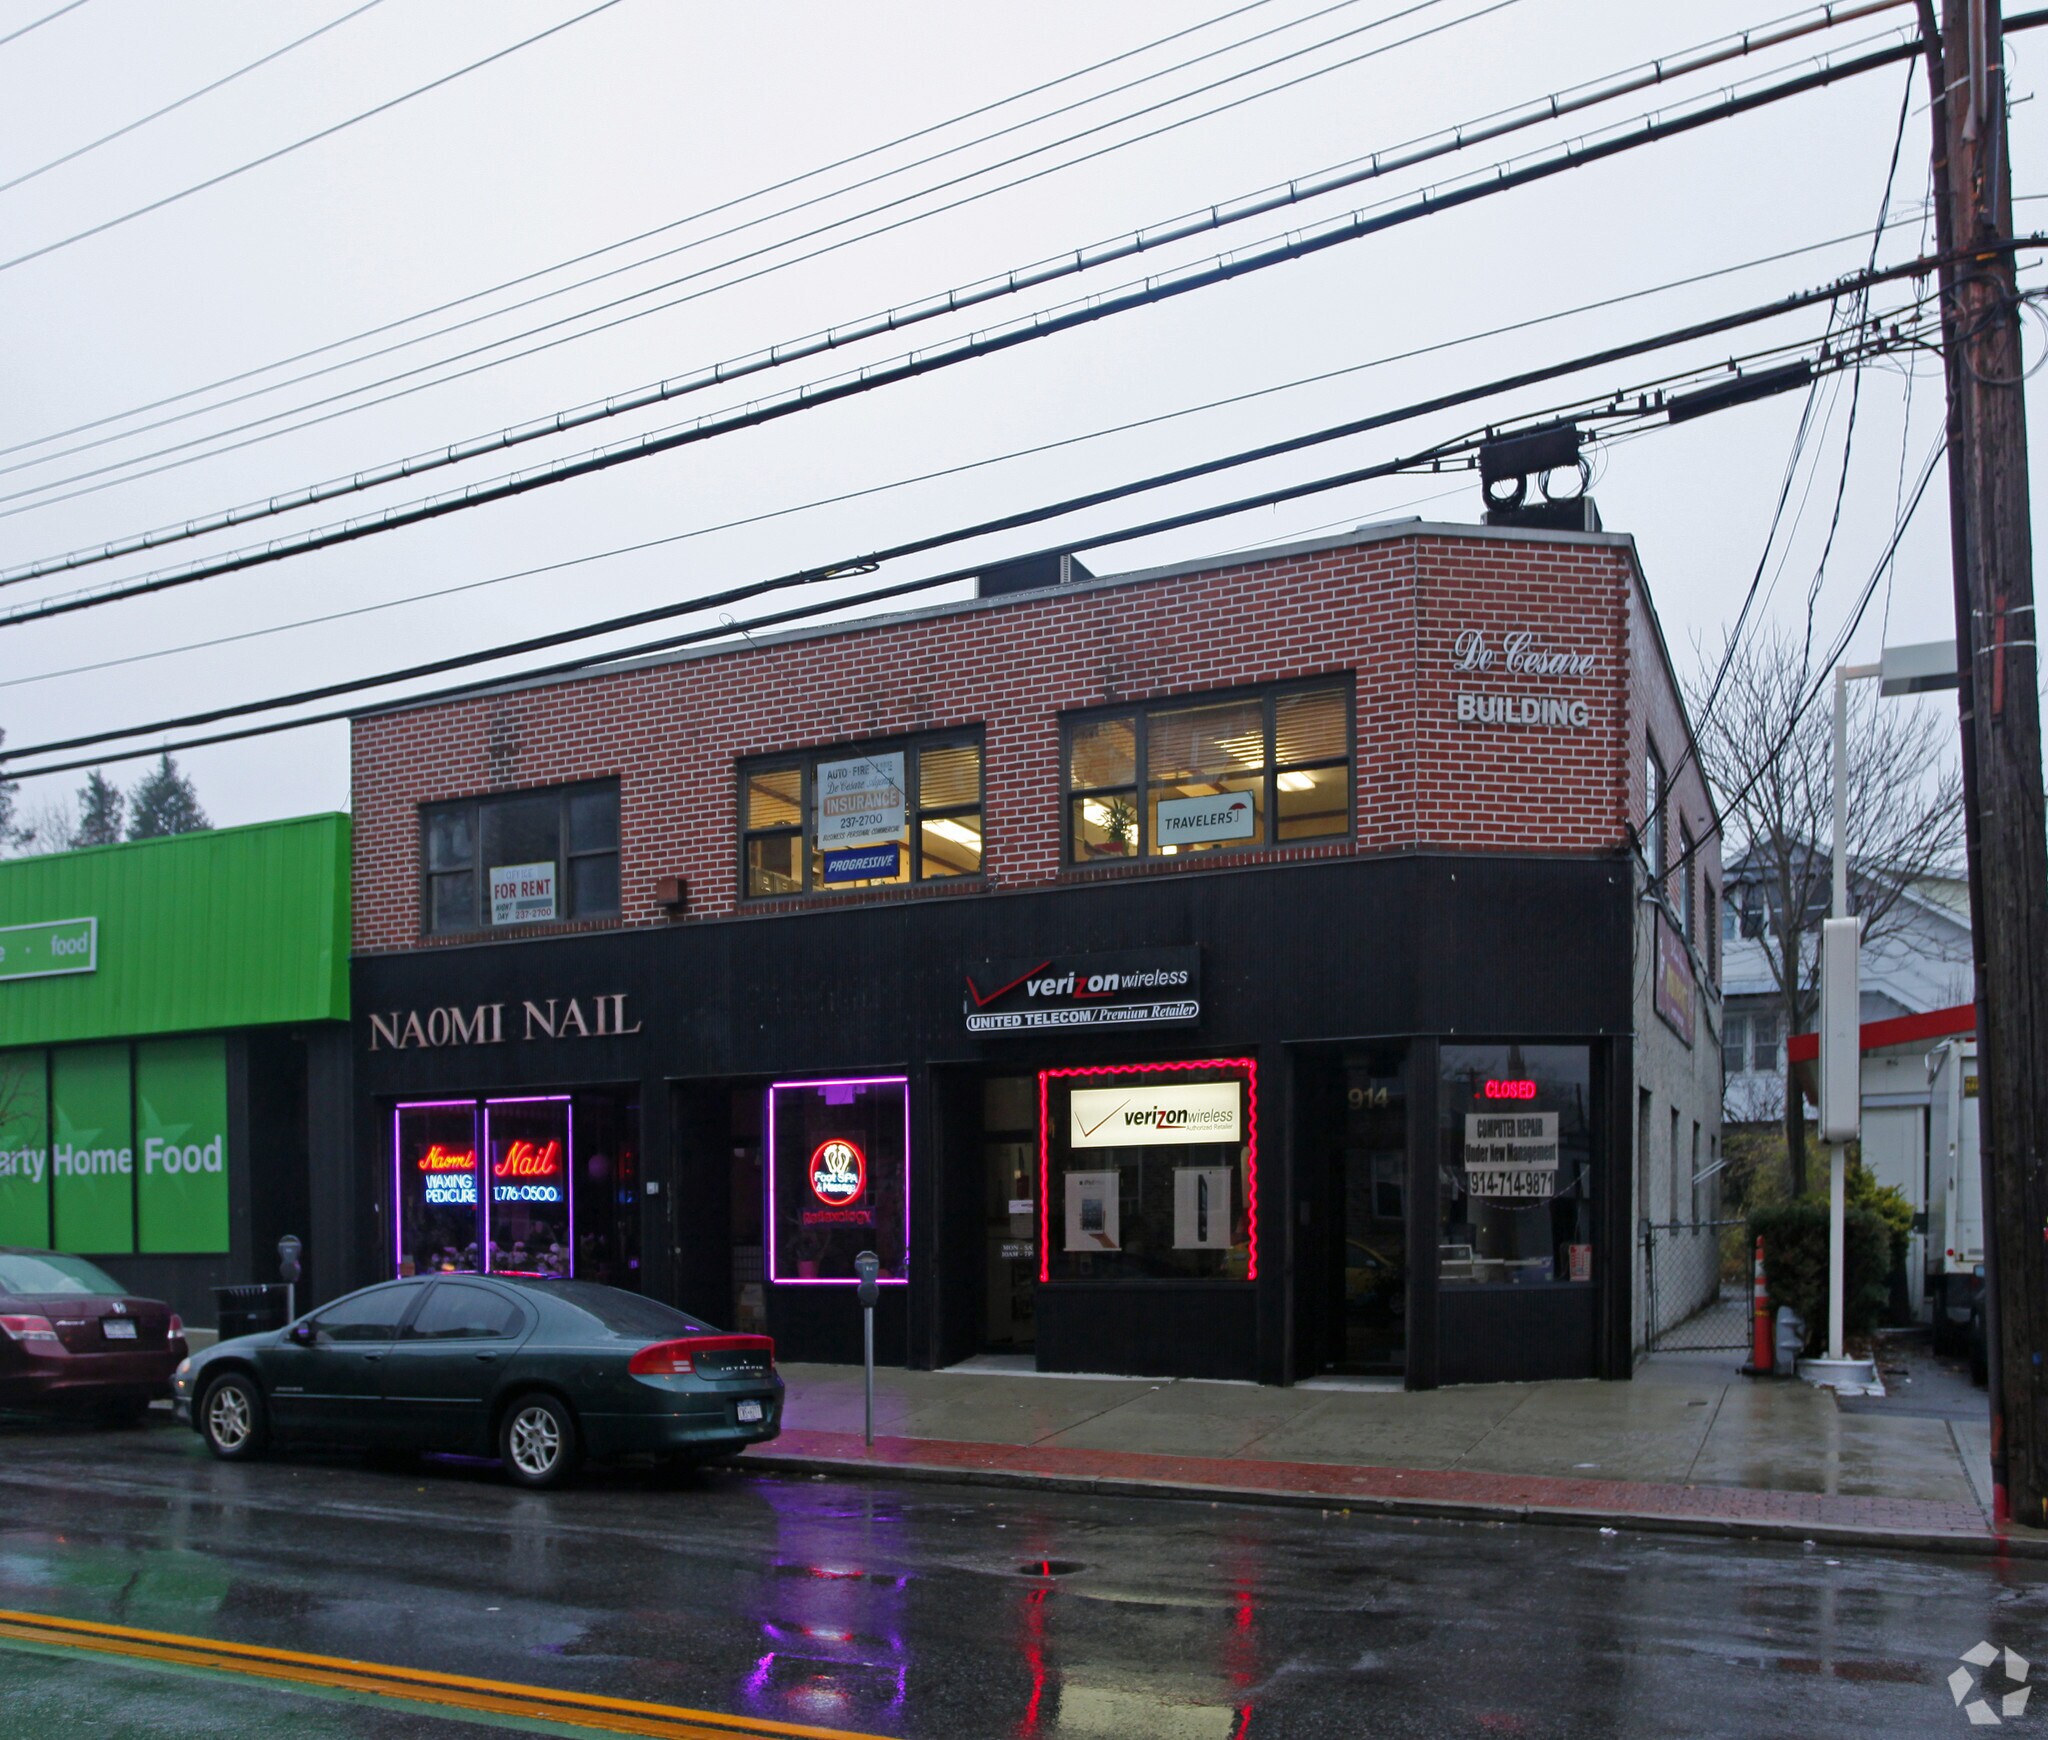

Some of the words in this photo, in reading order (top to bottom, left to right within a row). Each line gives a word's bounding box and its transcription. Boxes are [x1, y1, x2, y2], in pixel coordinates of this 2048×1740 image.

[1453, 628, 1494, 672] De
[1503, 631, 1595, 676] Cesare
[1456, 694, 1589, 727] BUILDING
[827, 768, 848, 780] AUTO
[852, 764, 870, 777] FIRE
[826, 790, 898, 815] INSURANCE
[840, 814, 883, 829] 237-2700
[1165, 811, 1233, 830] TRAVELERS
[828, 854, 895, 873] PROGRESSIVE
[494, 882, 517, 900] FOR
[520, 878, 551, 898] RENT
[515, 907, 552, 920] 237-2700
[51, 931, 88, 956] food
[1026, 971, 1119, 999] verizon
[1121, 969, 1188, 989] wireless
[368, 1003, 505, 1051] NAOMI
[522, 994, 643, 1041] NAIL
[970, 1014, 1022, 1029] UNITED
[1151, 1001, 1195, 1018] Retailer
[1347, 1087, 1390, 1110] 914
[1485, 1079, 1536, 1099] CLOSED
[1124, 1105, 1188, 1130] verizon
[1187, 1108, 1233, 1124] wireless
[1477, 1119, 1516, 1138] COMPUTER
[1517, 1118, 1543, 1137] REPAIR
[53, 1143, 132, 1176] Home
[145, 1134, 222, 1174] Food
[419, 1146, 475, 1169] Naomi
[495, 1140, 557, 1175] Nail
[1465, 1144, 1489, 1163] Under
[1489, 1144, 1506, 1162] New
[1507, 1143, 1556, 1163] Management
[426, 1174, 472, 1189] WAXING
[1471, 1171, 1554, 1195] 914-714-9871
[426, 1189, 477, 1203] PEDICURE
